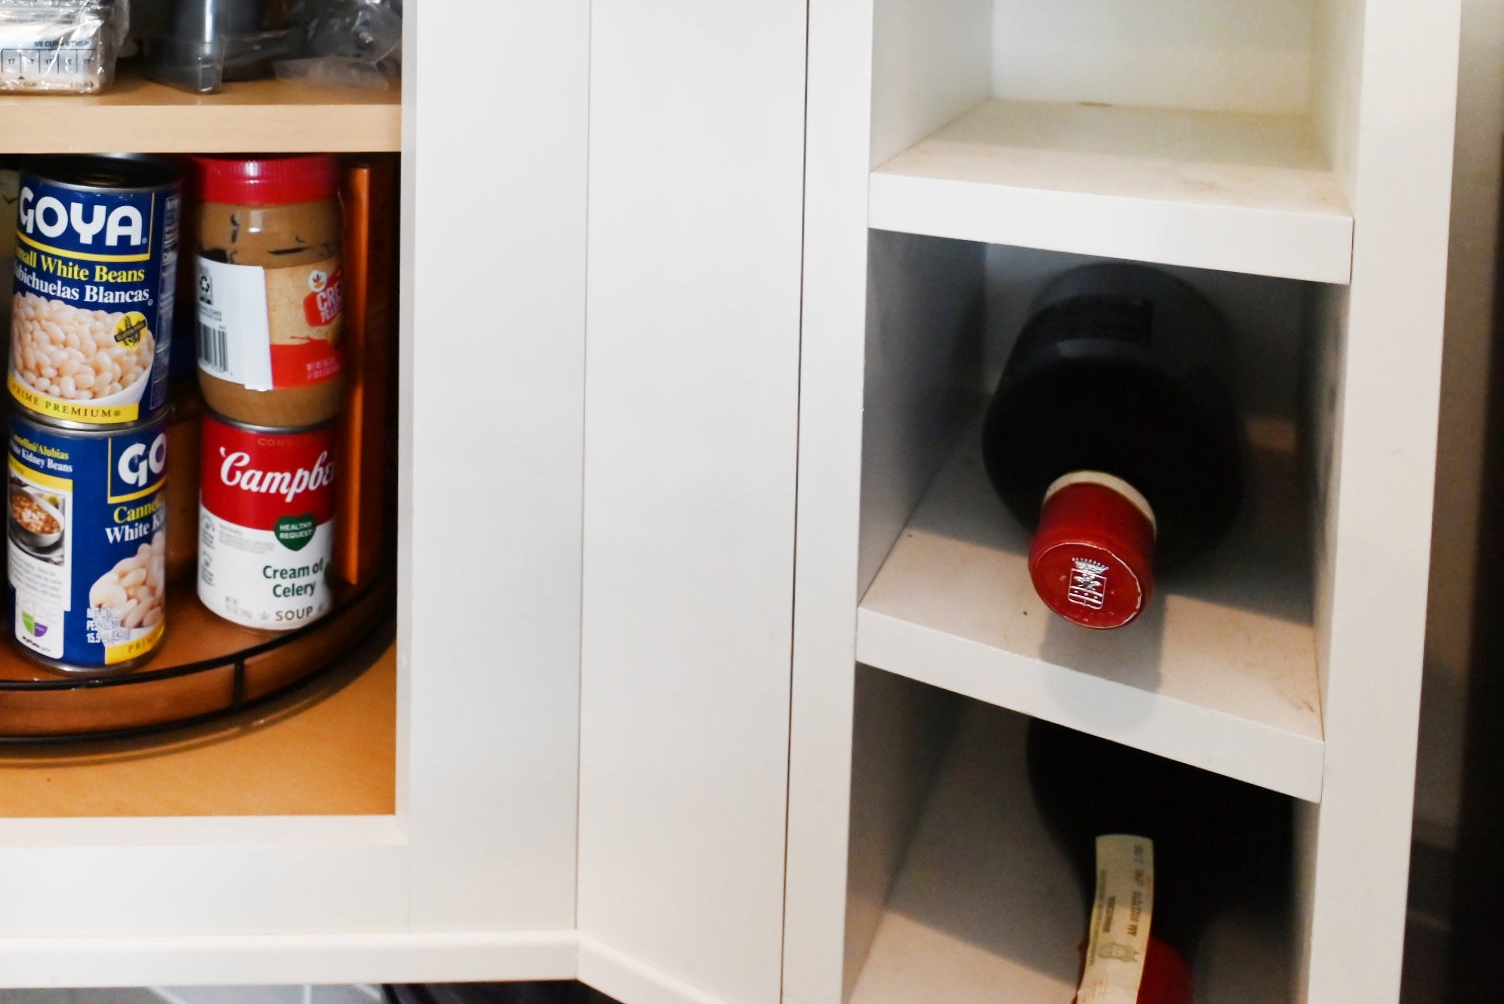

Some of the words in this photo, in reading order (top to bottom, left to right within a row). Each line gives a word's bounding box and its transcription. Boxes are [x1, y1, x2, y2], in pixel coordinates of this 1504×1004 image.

[19, 186, 143, 246] GOYA
[41, 254, 90, 282] White
[94, 265, 145, 283] Beans
[84, 284, 149, 304] Blancas
[45, 401, 112, 418] PREMIUM
[47, 458, 73, 473] Beans
[118, 432, 166, 487] GO
[105, 522, 150, 544] White
[279, 521, 313, 531] HEALTHY
[279, 529, 313, 539] REQUEST
[262, 564, 310, 579] Cream
[312, 557, 324, 574] of
[272, 581, 316, 598] Celery
[275, 606, 314, 621] SOUP
